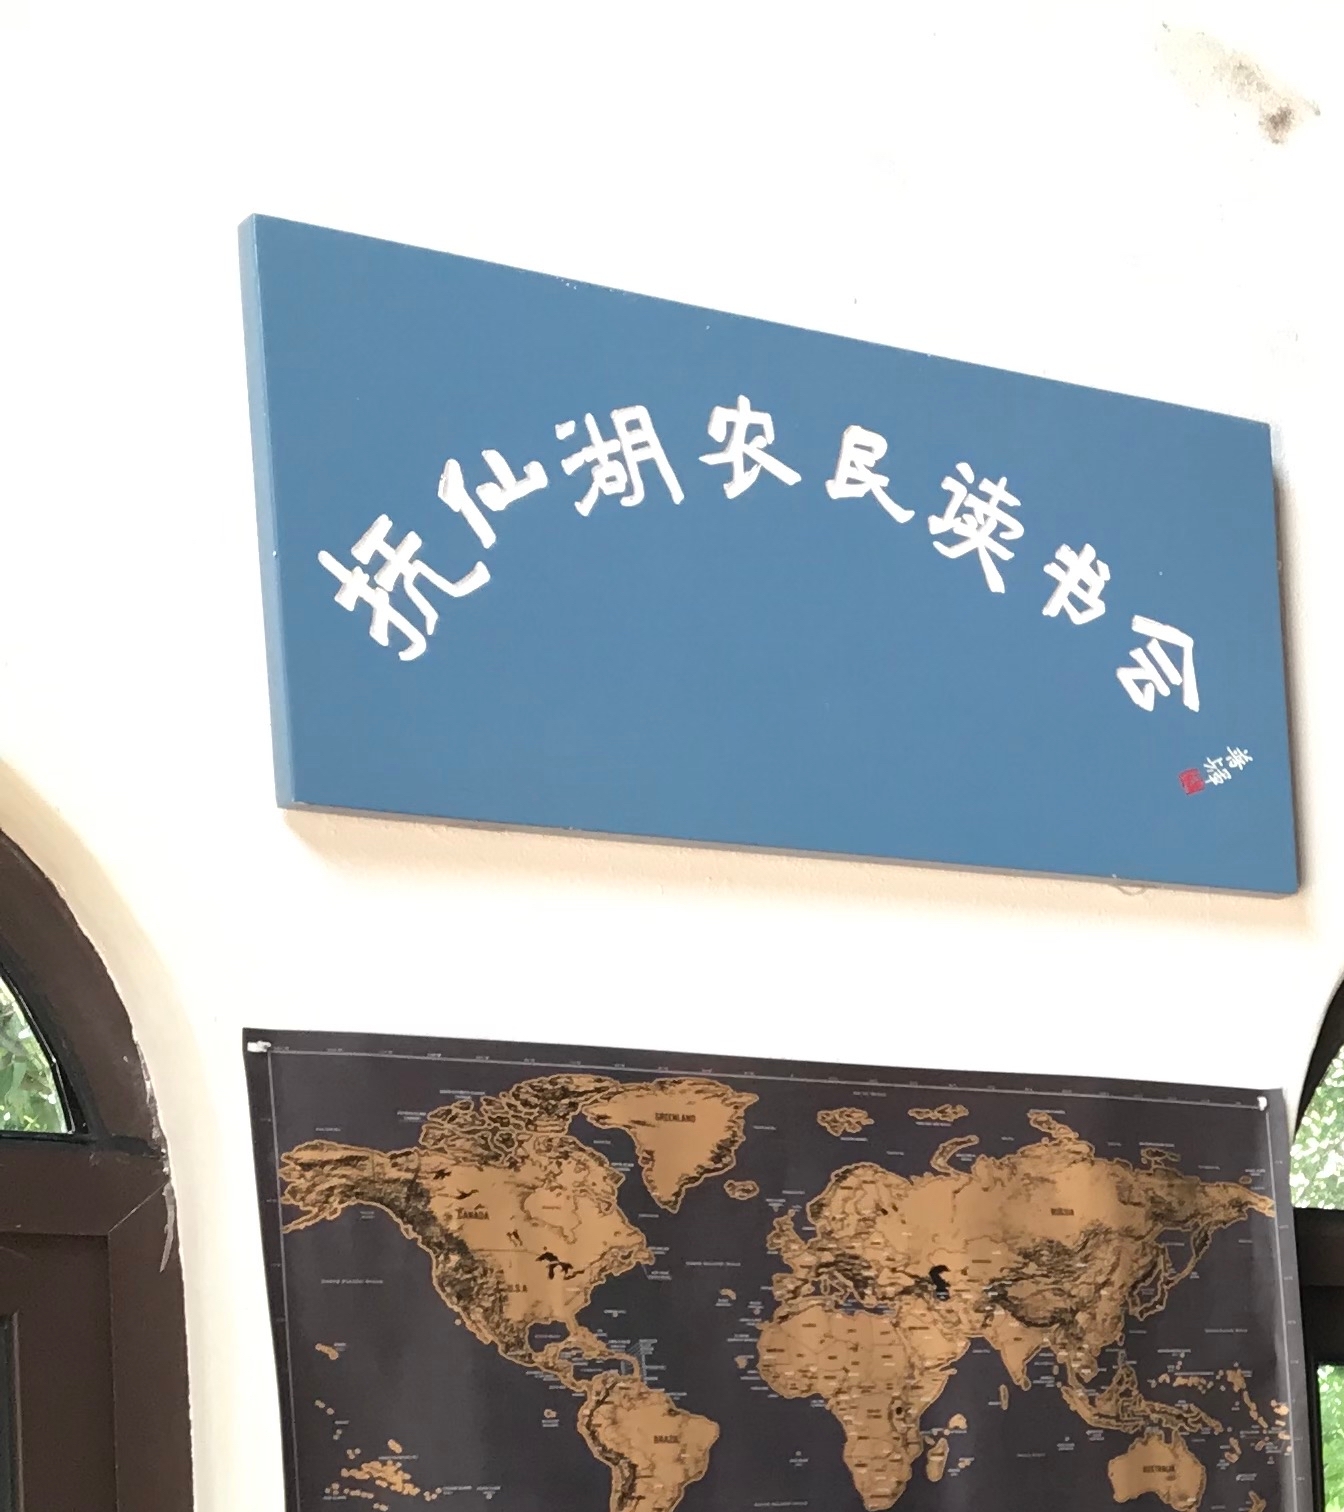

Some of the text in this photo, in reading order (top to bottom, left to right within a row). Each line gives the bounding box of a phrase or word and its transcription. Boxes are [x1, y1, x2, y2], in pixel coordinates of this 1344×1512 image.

[317, 395, 1202, 662] 抚仙湖农民读书会
